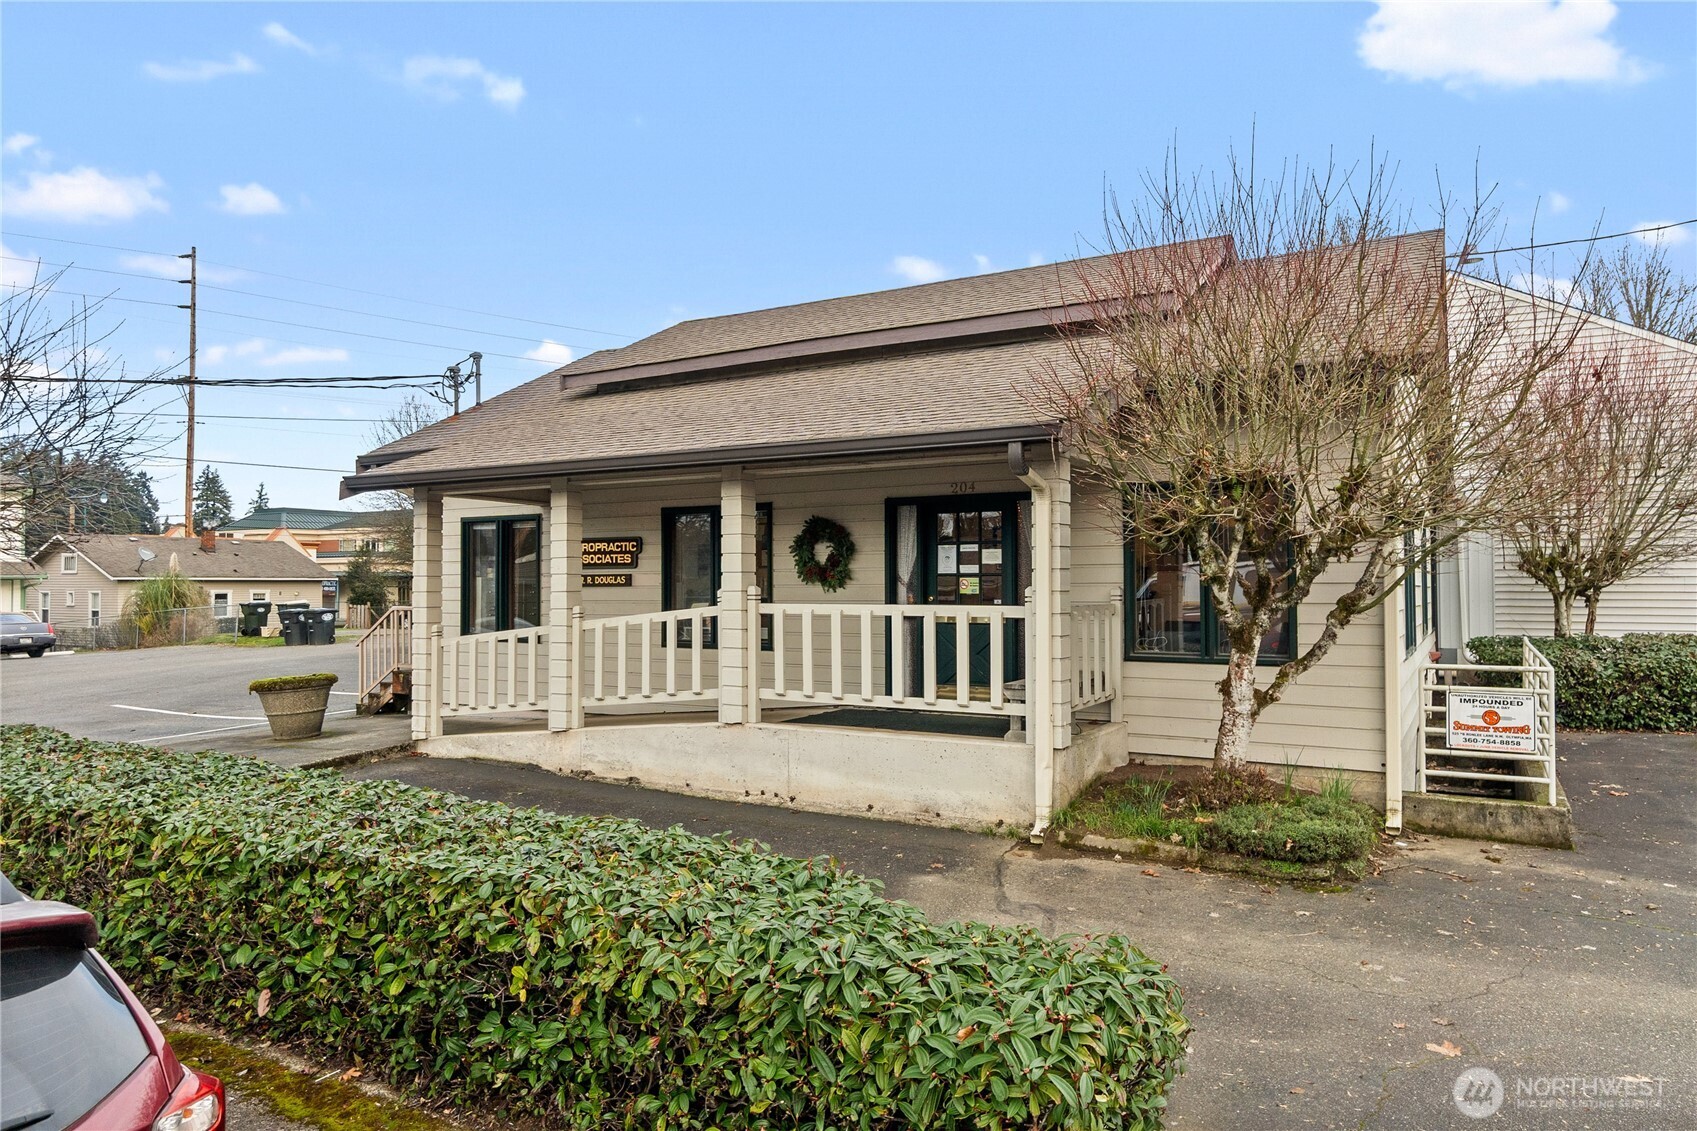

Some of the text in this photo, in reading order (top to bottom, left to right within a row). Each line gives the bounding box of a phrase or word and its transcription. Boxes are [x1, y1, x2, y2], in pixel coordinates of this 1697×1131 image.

[950, 481, 976, 494] 204
[581, 554, 632, 564] SOCIATES
[594, 576, 626, 584] DOUGLAS
[1459, 698, 1524, 706] IMPOUNDED
[1492, 724, 1531, 735] TOWING
[1462, 737, 1521, 746] 360-754-8858
